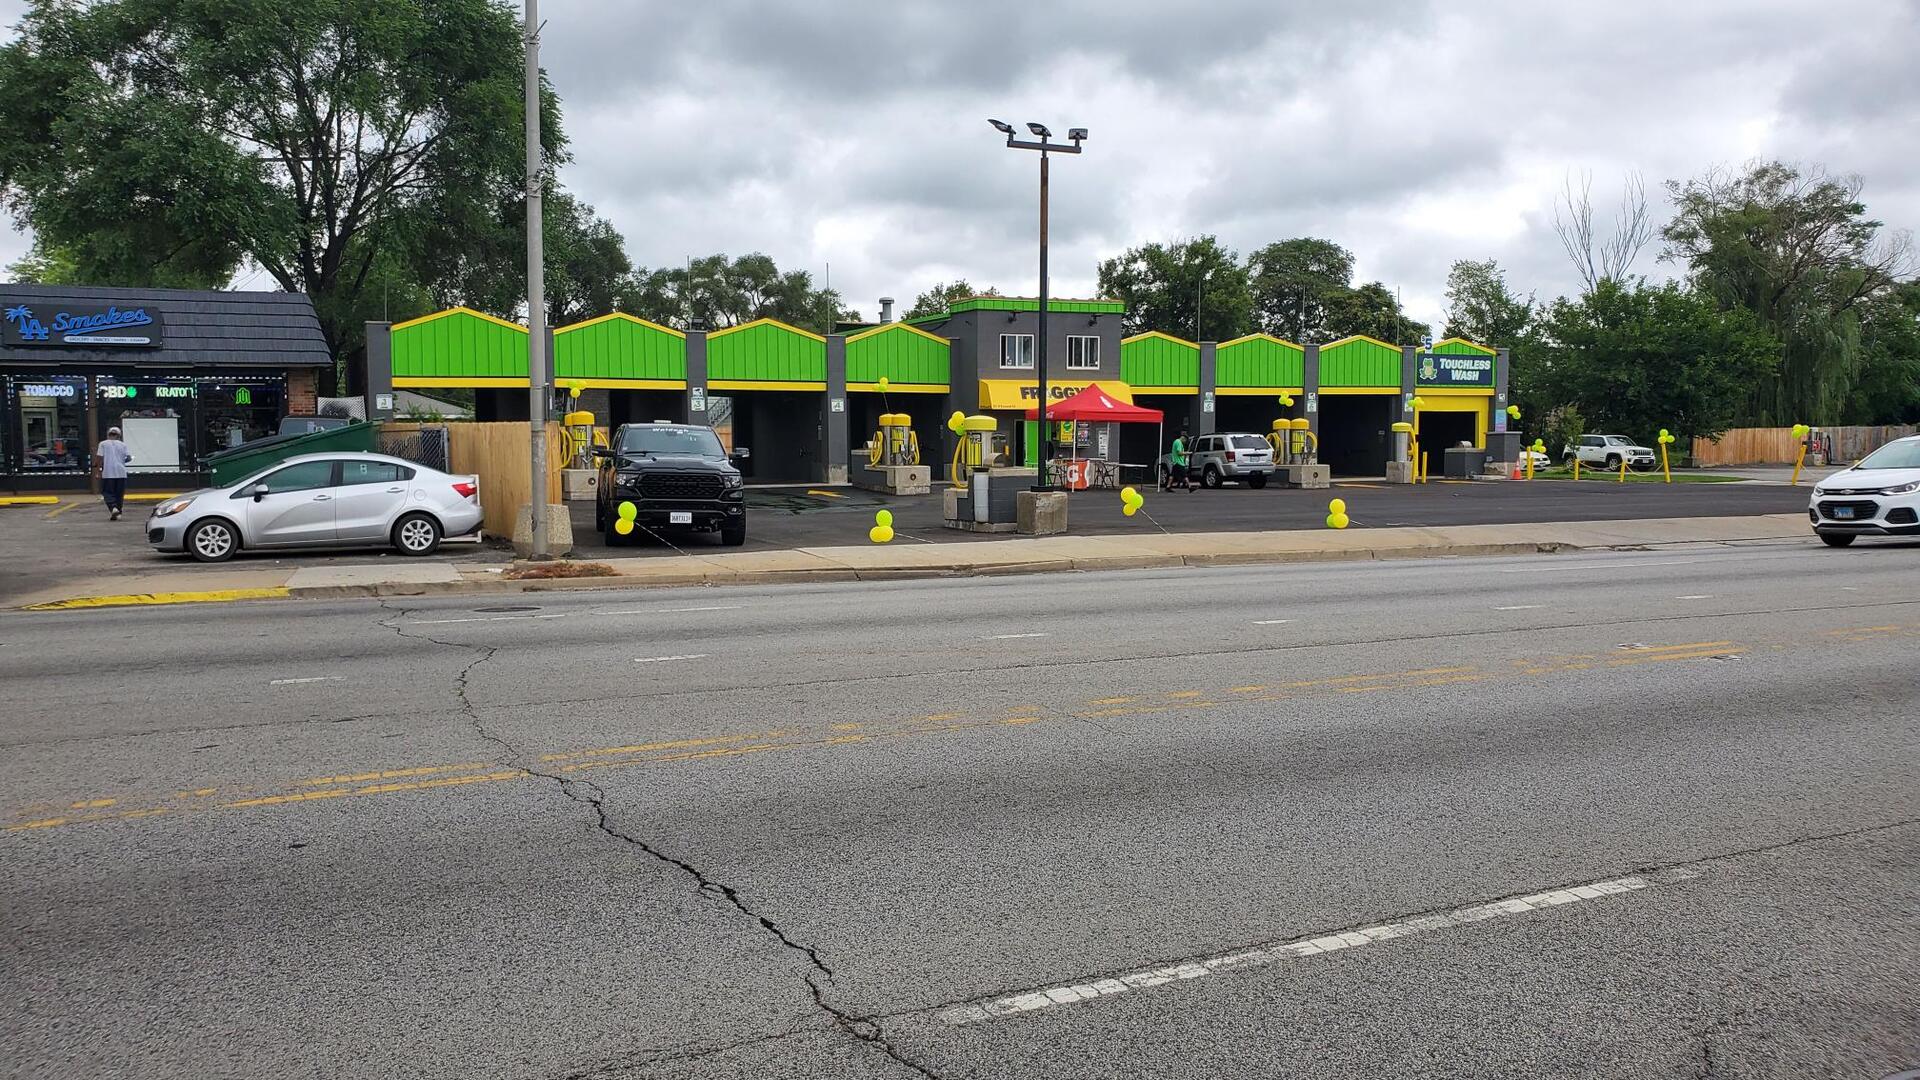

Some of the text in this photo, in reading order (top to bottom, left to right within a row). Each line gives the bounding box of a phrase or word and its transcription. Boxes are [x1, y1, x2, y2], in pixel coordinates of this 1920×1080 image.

[52, 306, 152, 332] Smokes
[1440, 358, 1491, 370] TOUCHLESS
[1451, 369, 1480, 381] WASH
[23, 385, 74, 397] TOBACCO
[1020, 386, 1086, 400] FRGGY
